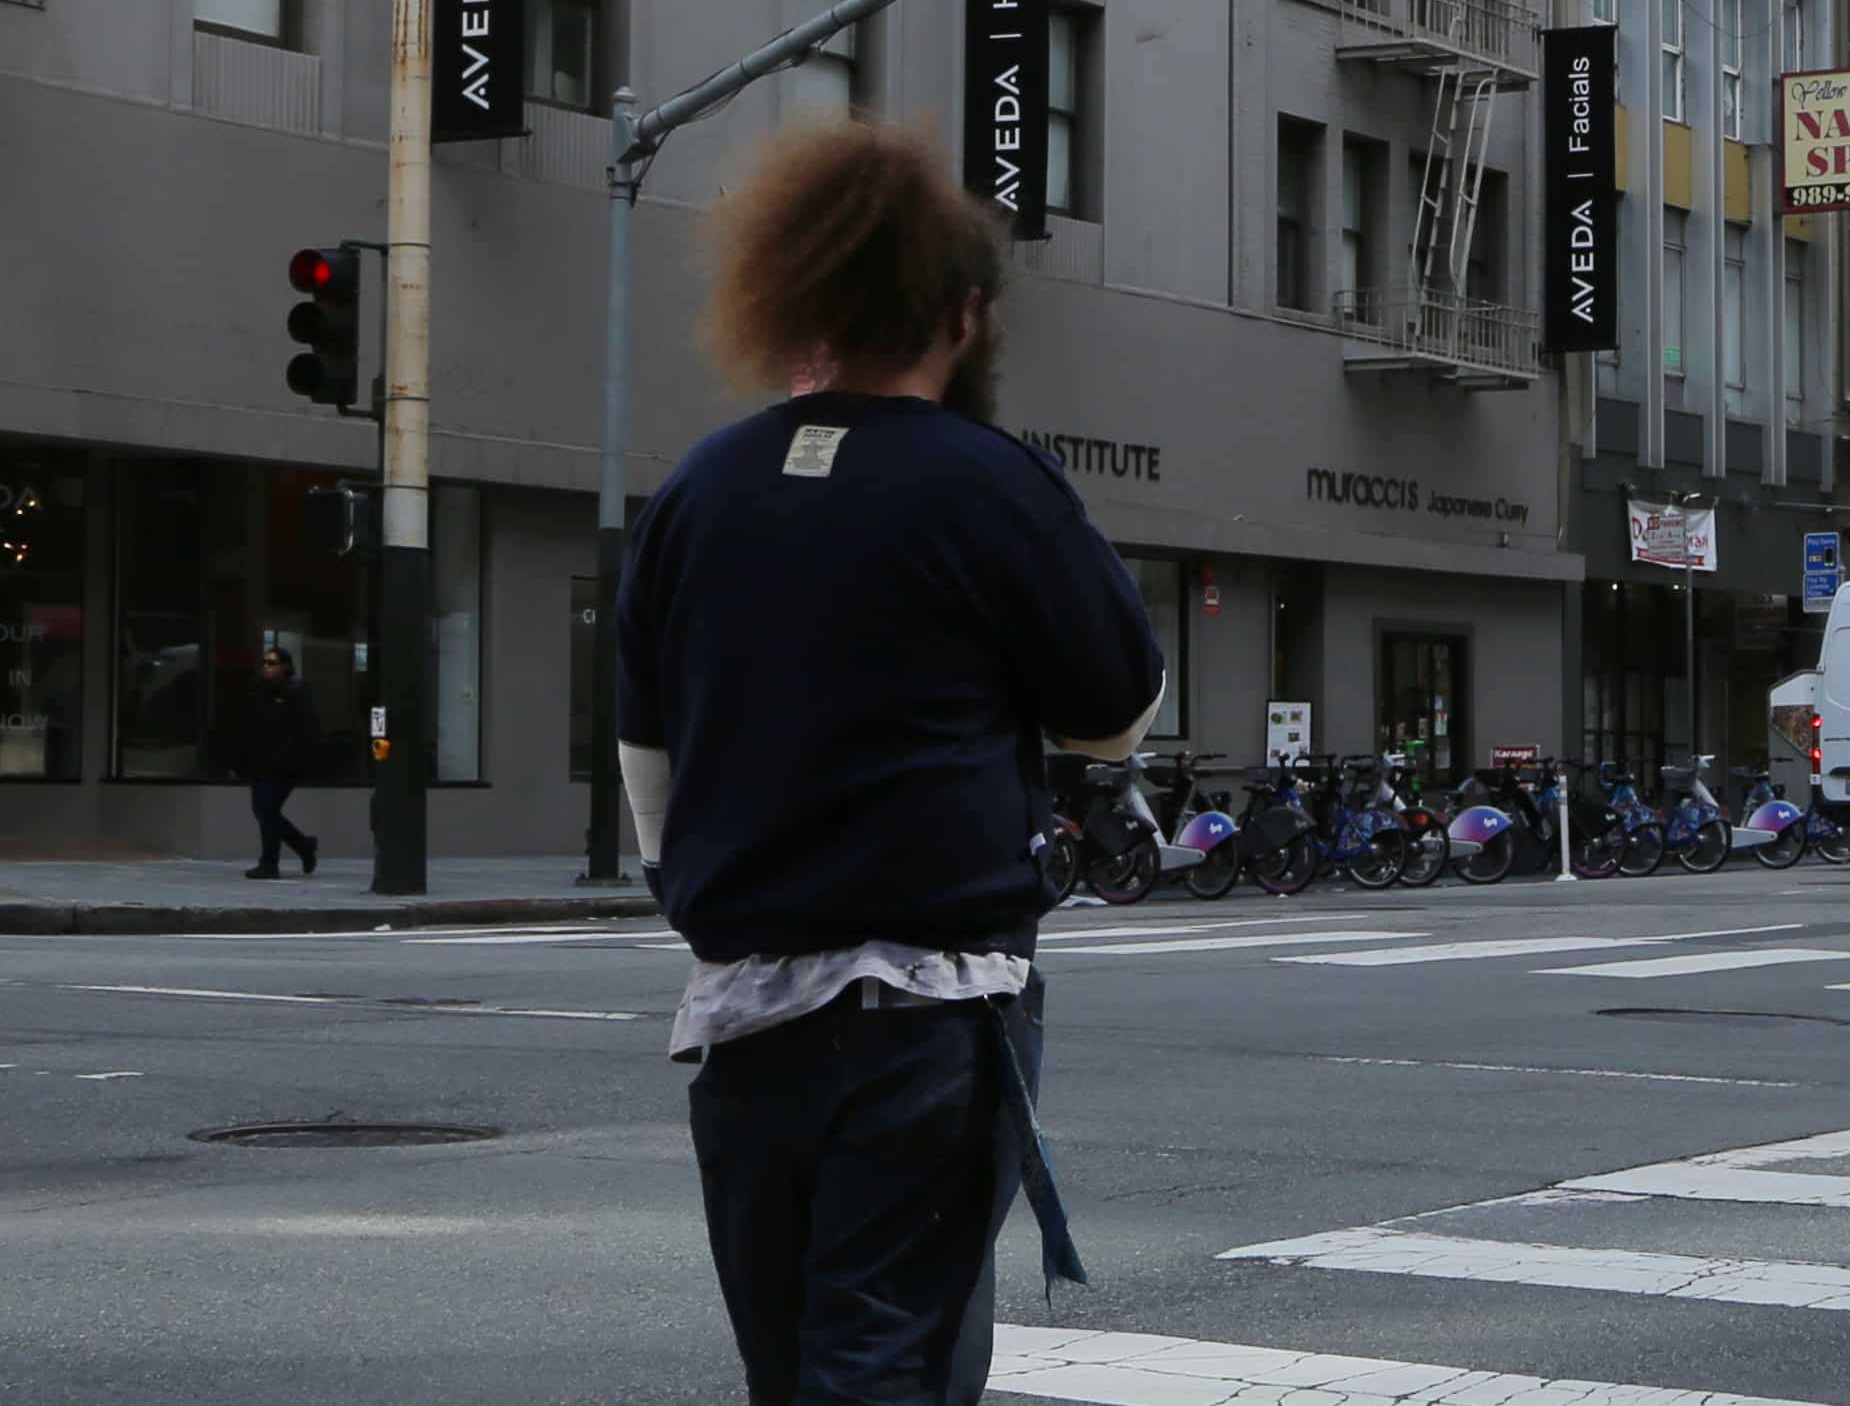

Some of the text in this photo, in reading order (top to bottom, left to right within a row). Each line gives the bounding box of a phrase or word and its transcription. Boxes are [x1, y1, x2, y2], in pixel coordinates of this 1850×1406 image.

[992, 63, 1021, 212] AVEDA
[1791, 79, 1849, 110] Yellow
[1568, 55, 1597, 323] AVEDA Facials
